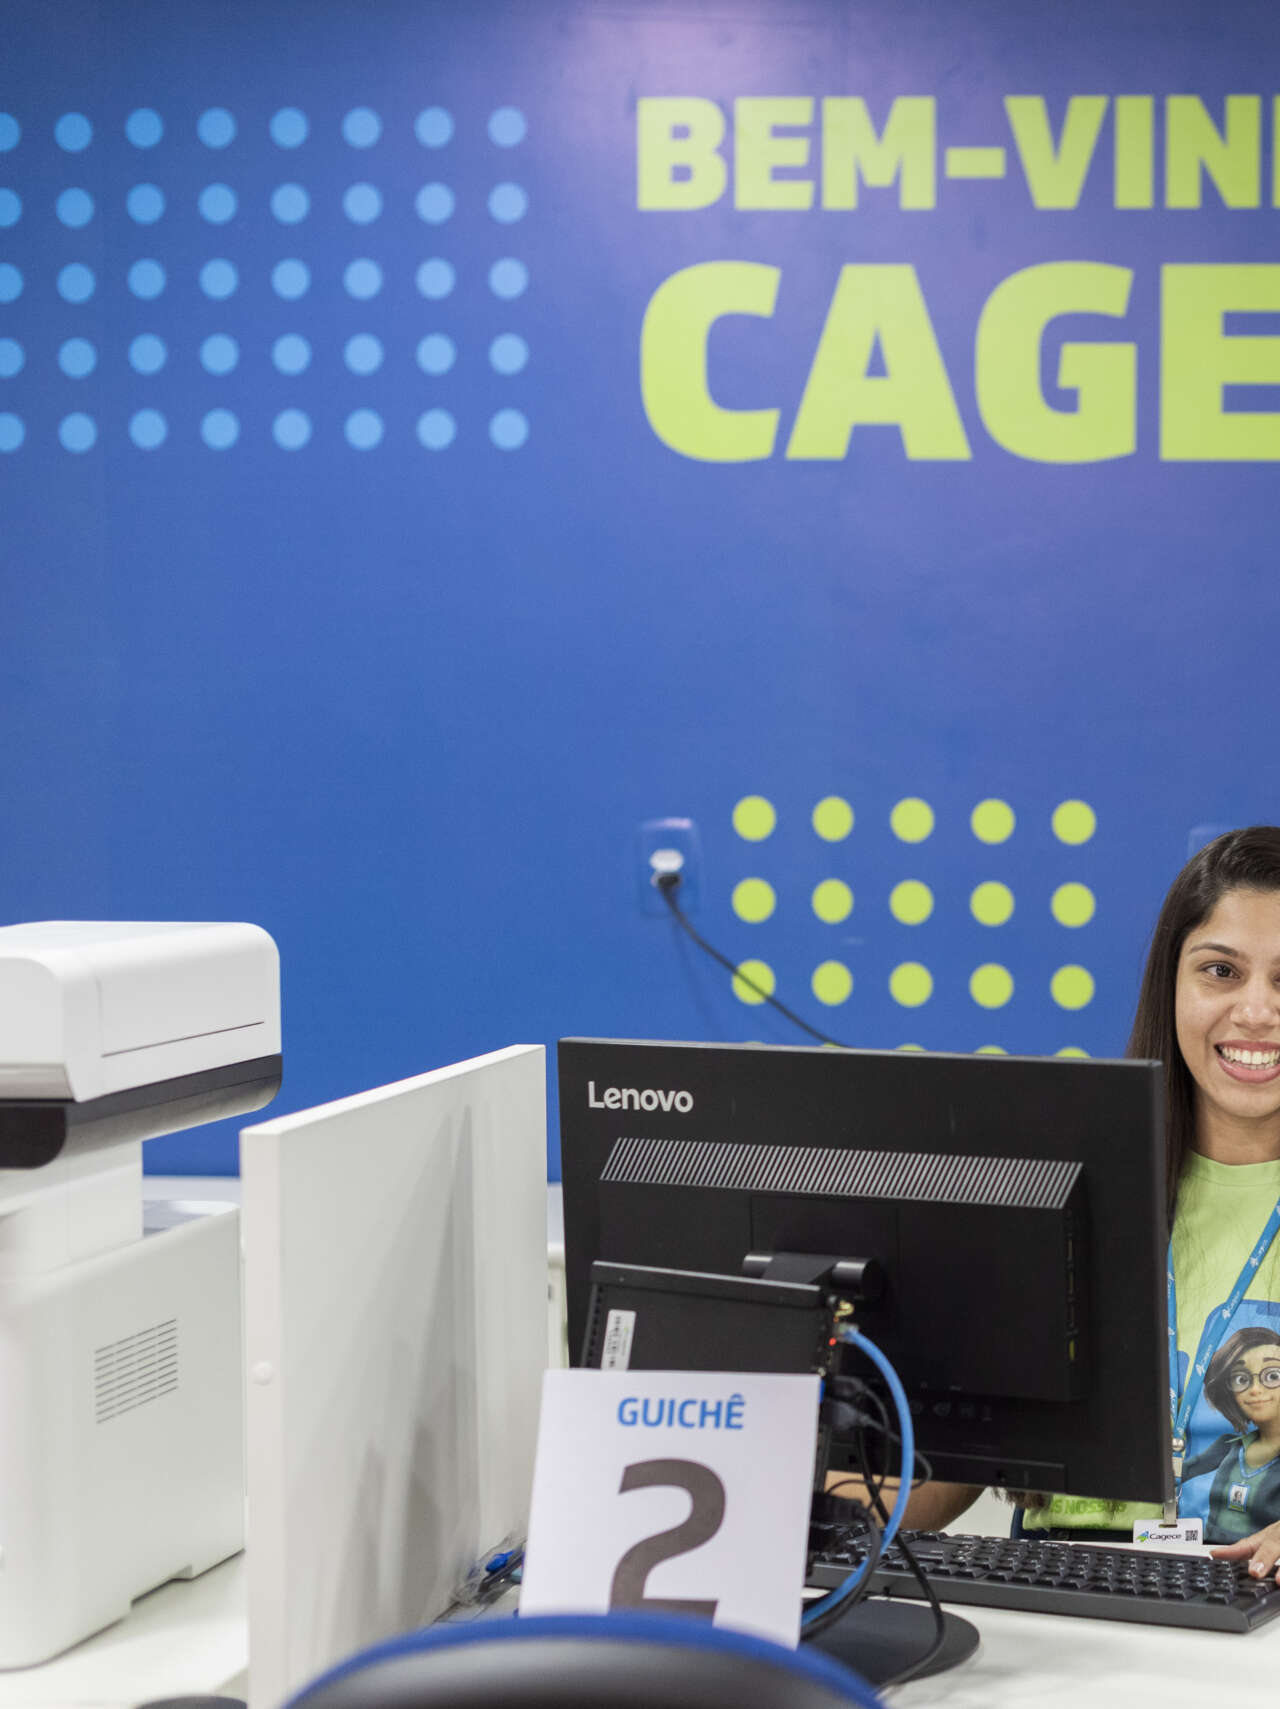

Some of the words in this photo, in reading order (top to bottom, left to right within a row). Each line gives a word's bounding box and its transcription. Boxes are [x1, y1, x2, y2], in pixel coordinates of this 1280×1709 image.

[587, 1081, 694, 1114] Lenovo
[617, 1393, 746, 1430] GUICHÊ
[607, 1458, 727, 1624] 2
[1149, 1532, 1182, 1542] Cagece
